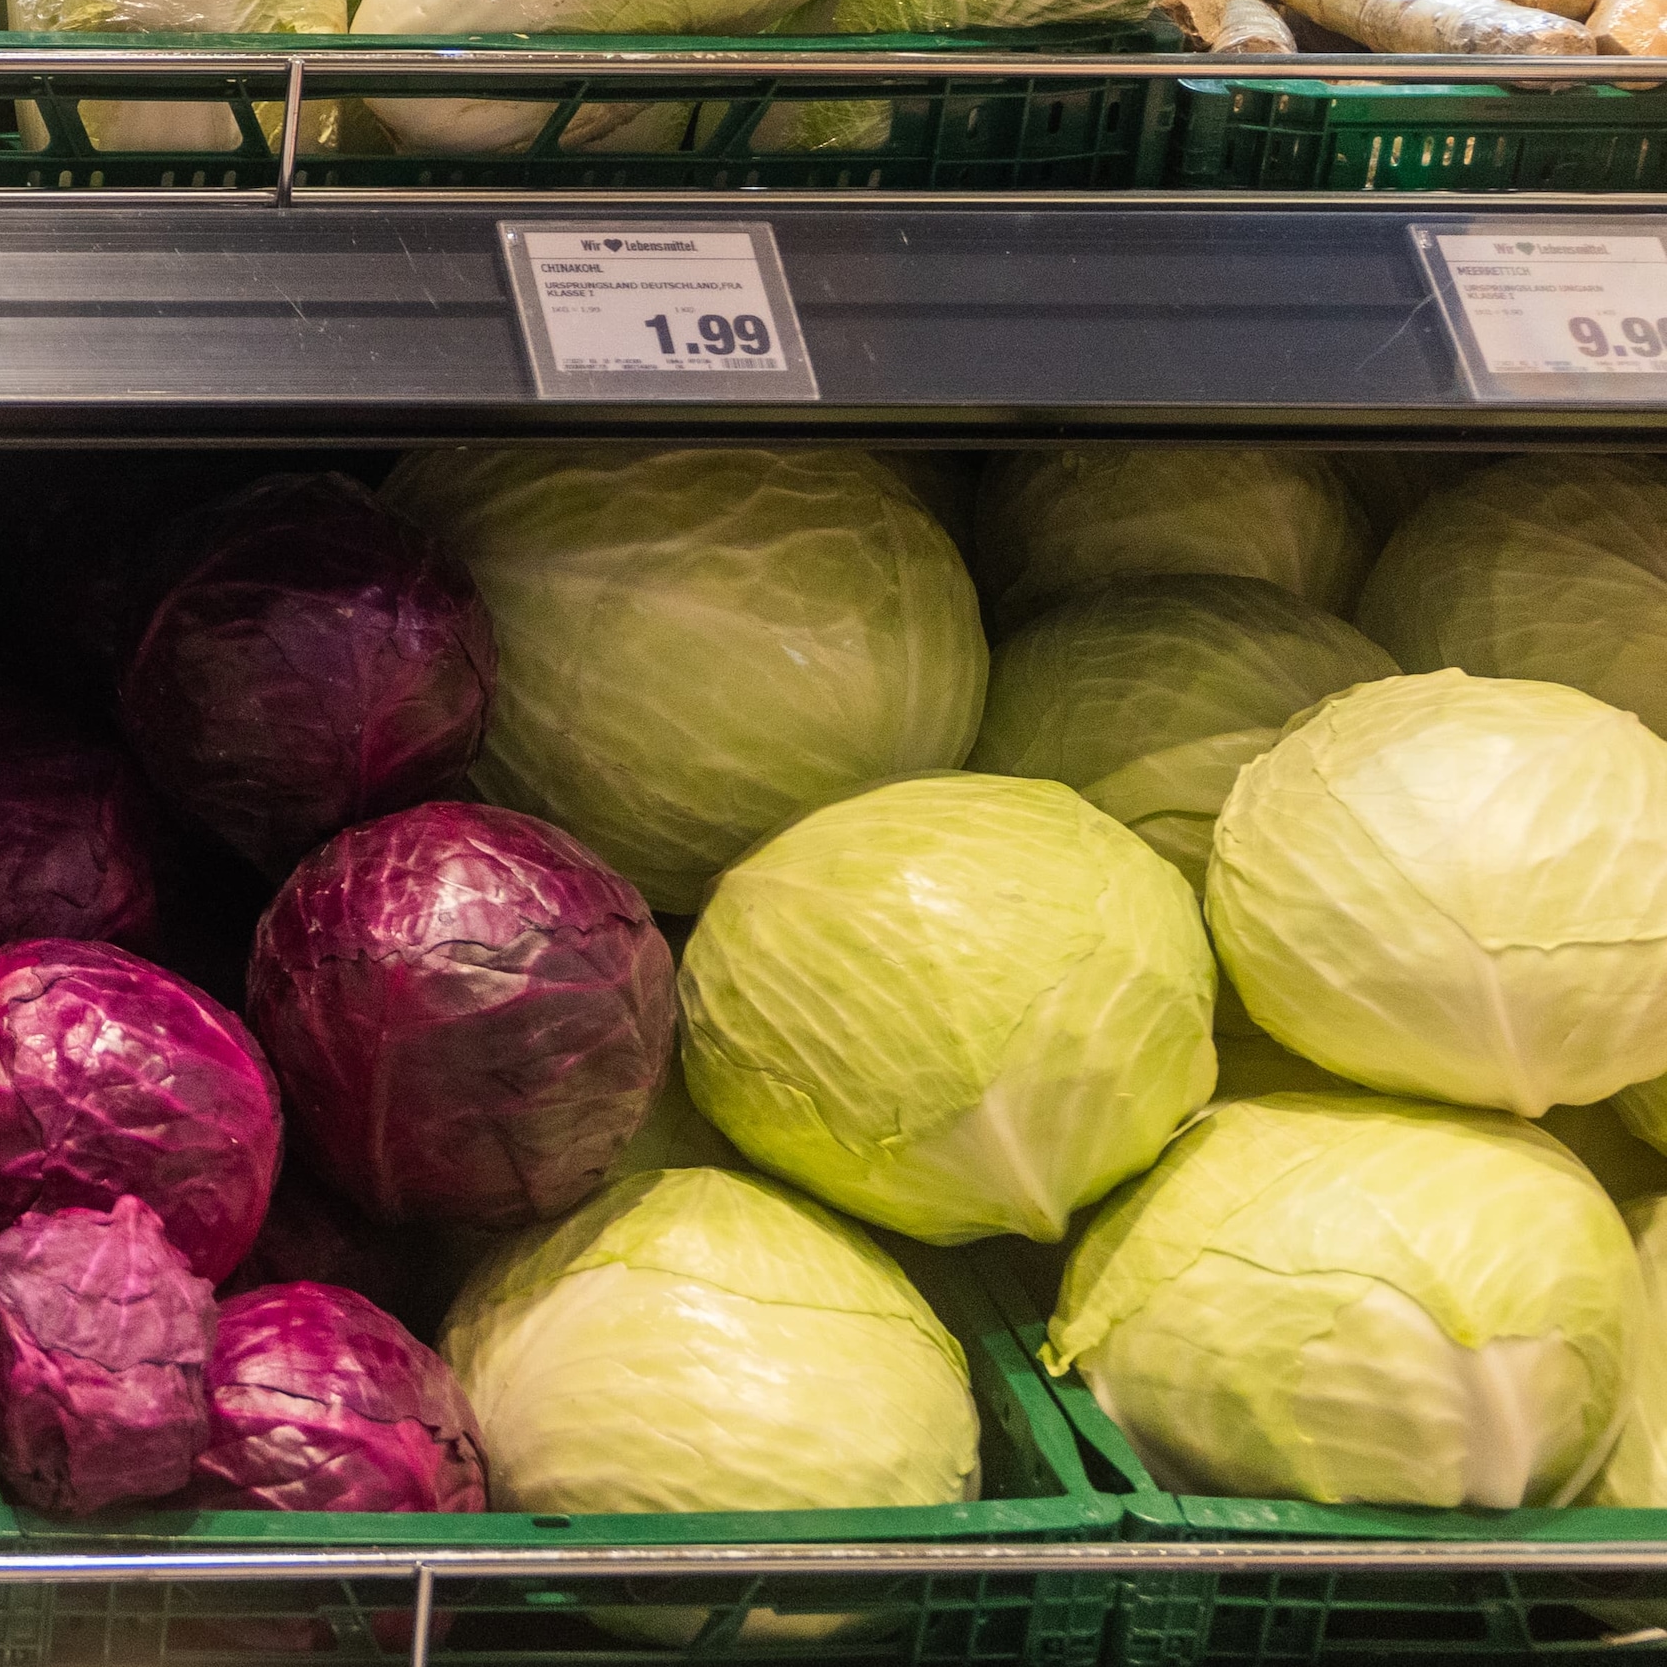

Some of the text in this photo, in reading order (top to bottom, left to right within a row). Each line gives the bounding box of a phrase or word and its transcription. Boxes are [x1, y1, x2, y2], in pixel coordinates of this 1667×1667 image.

[581, 239, 601, 252] Wir
[1493, 244, 1514, 255] Wir
[540, 263, 604, 273] CHINAKOHL
[1457, 267, 1531, 276] MEERRETTICH
[545, 282, 638, 290] URSPRUNGSLAND
[644, 314, 770, 356] 1.99
[1568, 316, 1667, 358] 9.9
